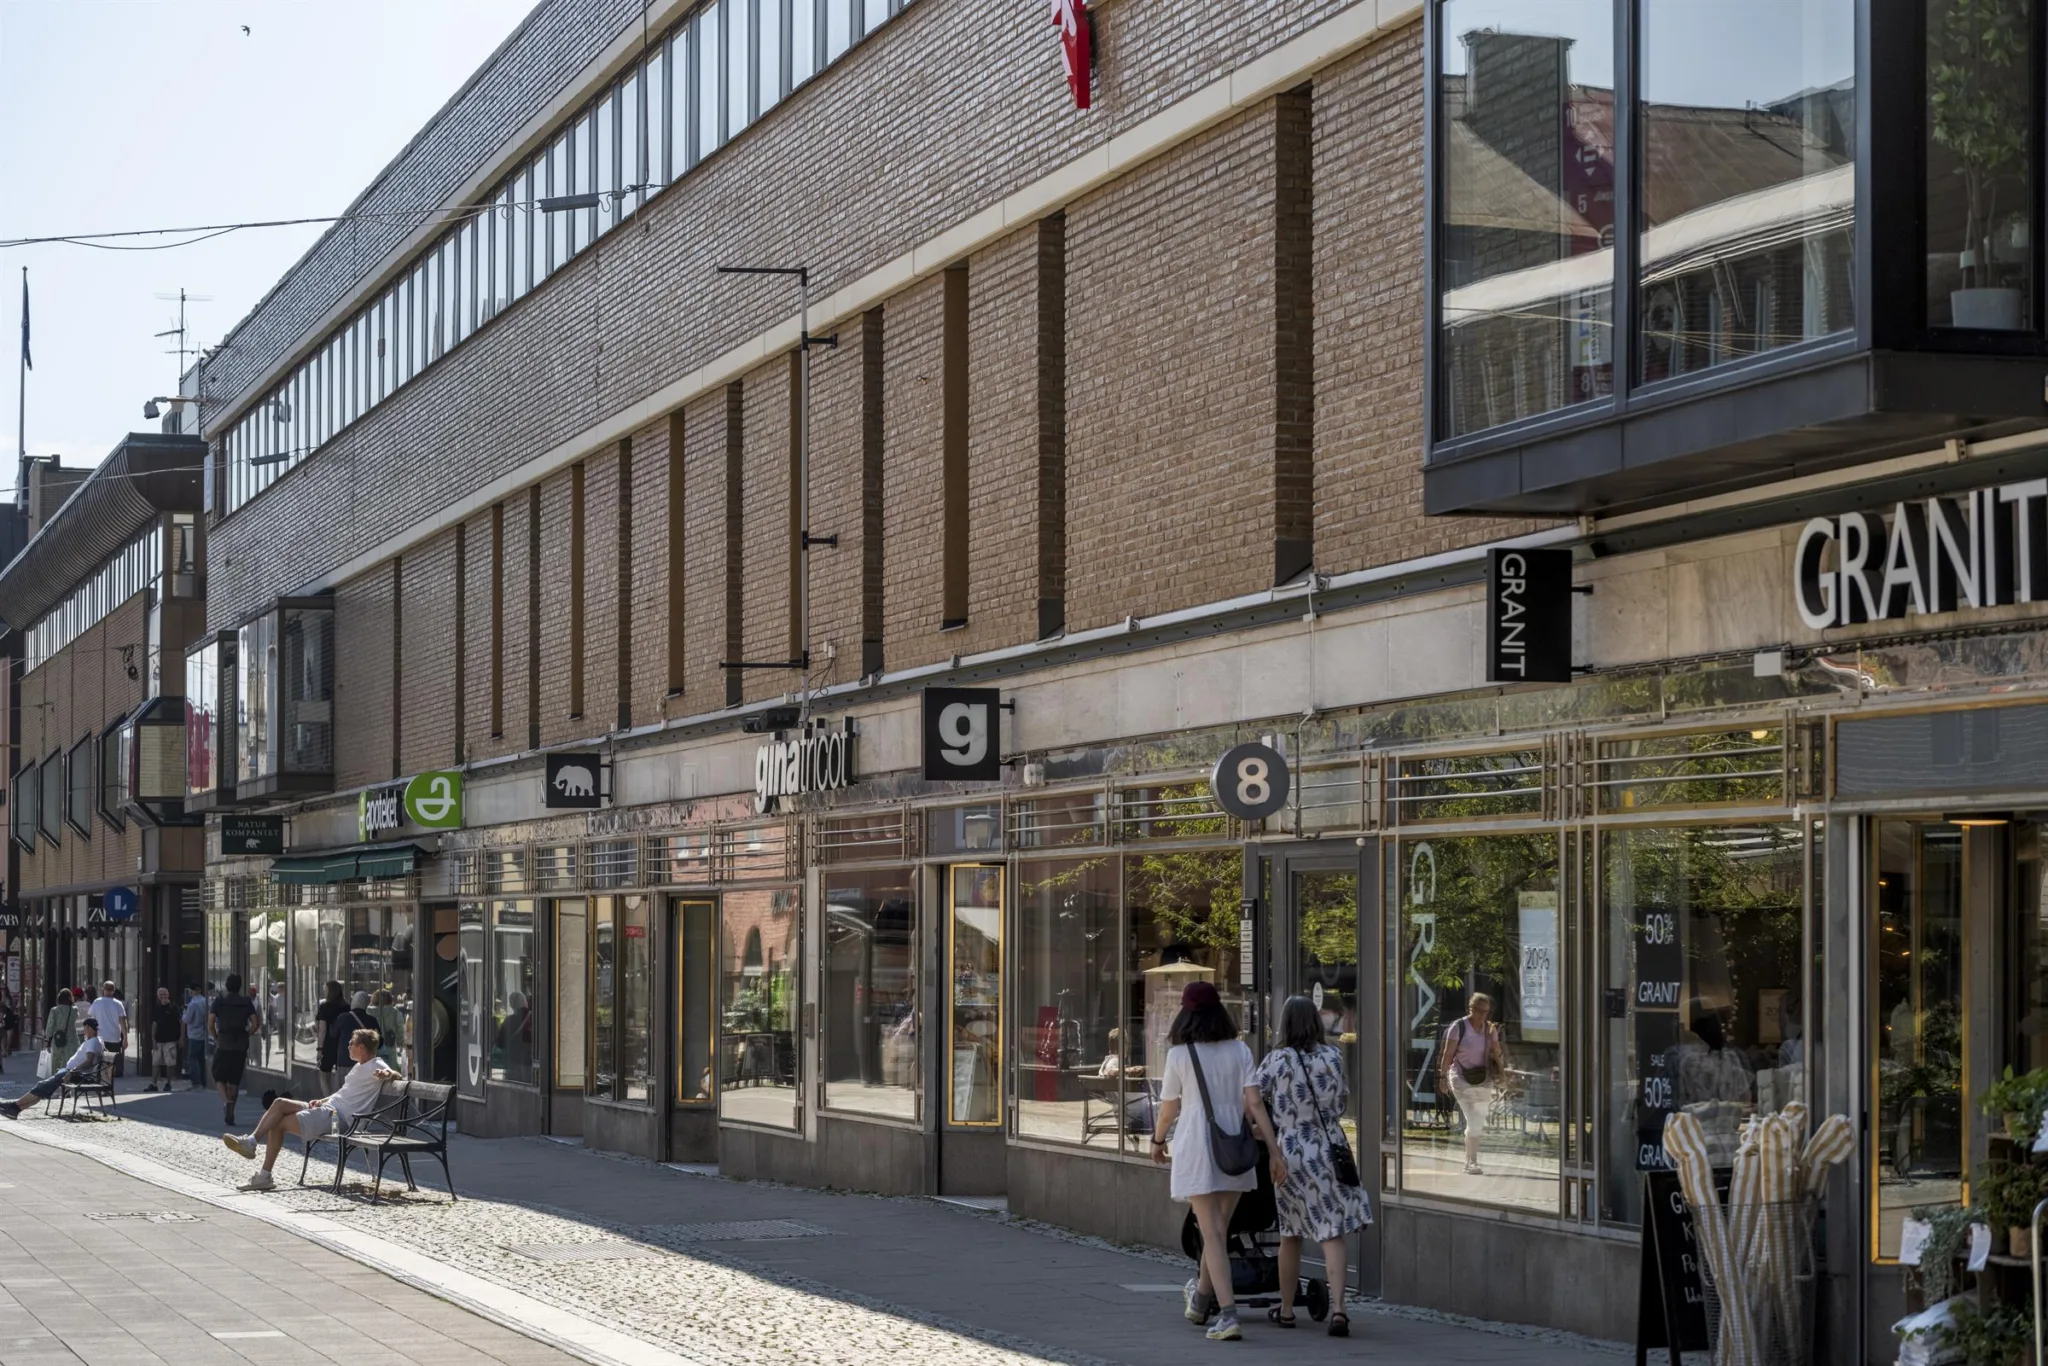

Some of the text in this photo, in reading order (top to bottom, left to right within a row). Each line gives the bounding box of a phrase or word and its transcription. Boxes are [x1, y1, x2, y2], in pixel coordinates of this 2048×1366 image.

[1794, 478, 2048, 630] GRANIT
[1501, 553, 1527, 677] GRANIT
[939, 702, 988, 766] g
[1236, 757, 1271, 806] 8
[237, 820, 267, 828] NATUR
[366, 788, 398, 840] apoteket
[1525, 947, 1550, 970] 20%
[1638, 981, 1680, 1003] GRANIT
[1650, 1054, 1665, 1067] SALE
[1644, 1077, 1672, 1108] 50%
